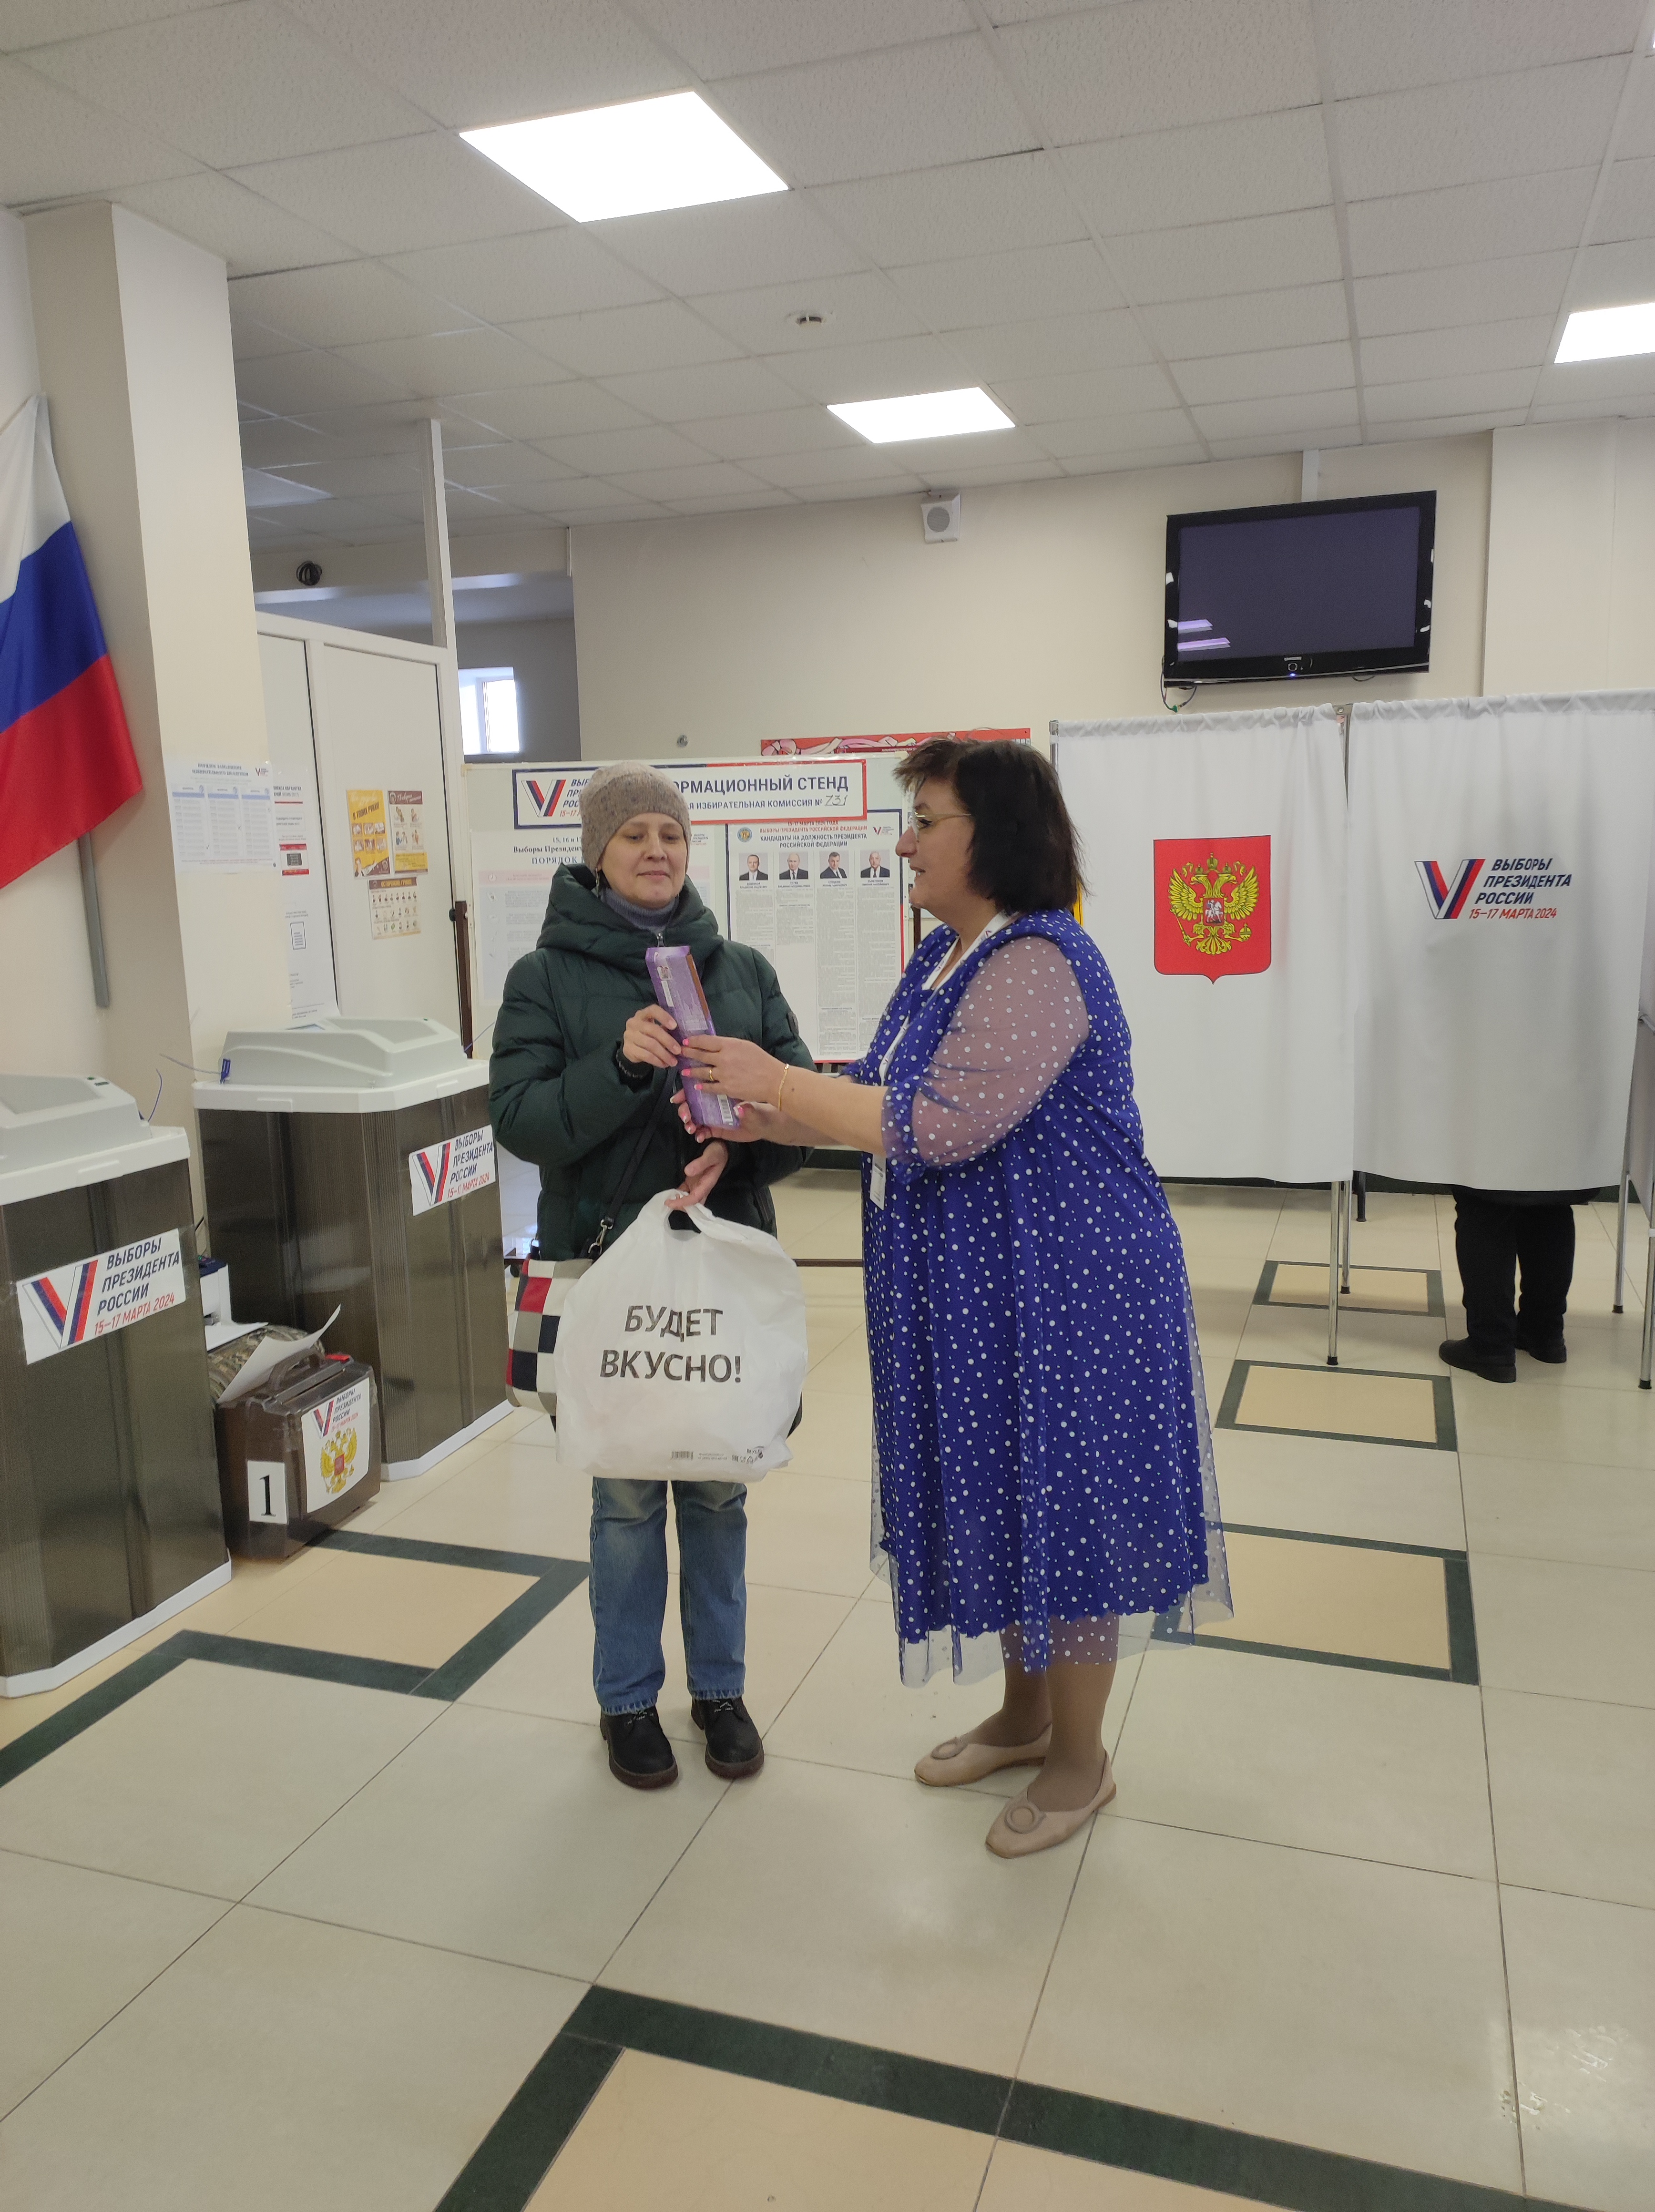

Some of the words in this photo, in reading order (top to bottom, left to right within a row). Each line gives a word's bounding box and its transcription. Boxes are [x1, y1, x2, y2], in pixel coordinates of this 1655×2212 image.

[673, 774, 792, 795] РМАЦИОННЫЙ
[798, 776, 848, 792] СТЕНД
[696, 800, 765, 809] ИЗБИРАТЕЛЬНАЯ
[767, 799, 812, 808] КОМИССИЯ
[513, 846, 542, 854] Выборы
[531, 856, 578, 865] ПОРЯДОК
[1491, 858, 1553, 871] ВЫБОРЫ
[1483, 874, 1572, 889] ПРЕЗИДЕНТА
[1474, 892, 1535, 905] РОССИИ
[1469, 908, 1499, 919] 15–17
[1499, 908, 1533, 919] МАРТА
[1534, 907, 1557, 919] 2024
[455, 1129, 483, 1151] ВЫБОРЫ
[453, 1141, 492, 1168] ПРЕЗИДЕНТА
[450, 1162, 477, 1185] РОССИИ
[462, 1177, 478, 1193] МАРТА
[479, 1172, 490, 1186] 2024
[106, 1237, 162, 1271] ВЫБОРЫ
[102, 1251, 179, 1293] ПРЕЗИДЕНТА
[97, 1281, 149, 1316] РОССИИ
[95, 1313, 121, 1336] 15–17
[123, 1301, 151, 1324] МАРТА
[153, 1292, 174, 1311] 2024
[624, 1305, 723, 1342] БУДЕТ
[600, 1349, 741, 1383] ВКУСНО!
[334, 1393, 361, 1414] ПРЕЗИДЕНТА
[336, 1388, 356, 1405] ВЫБОРЫ
[332, 1408, 350, 1424] РОССИИ
[259, 1474, 276, 1516] 1
